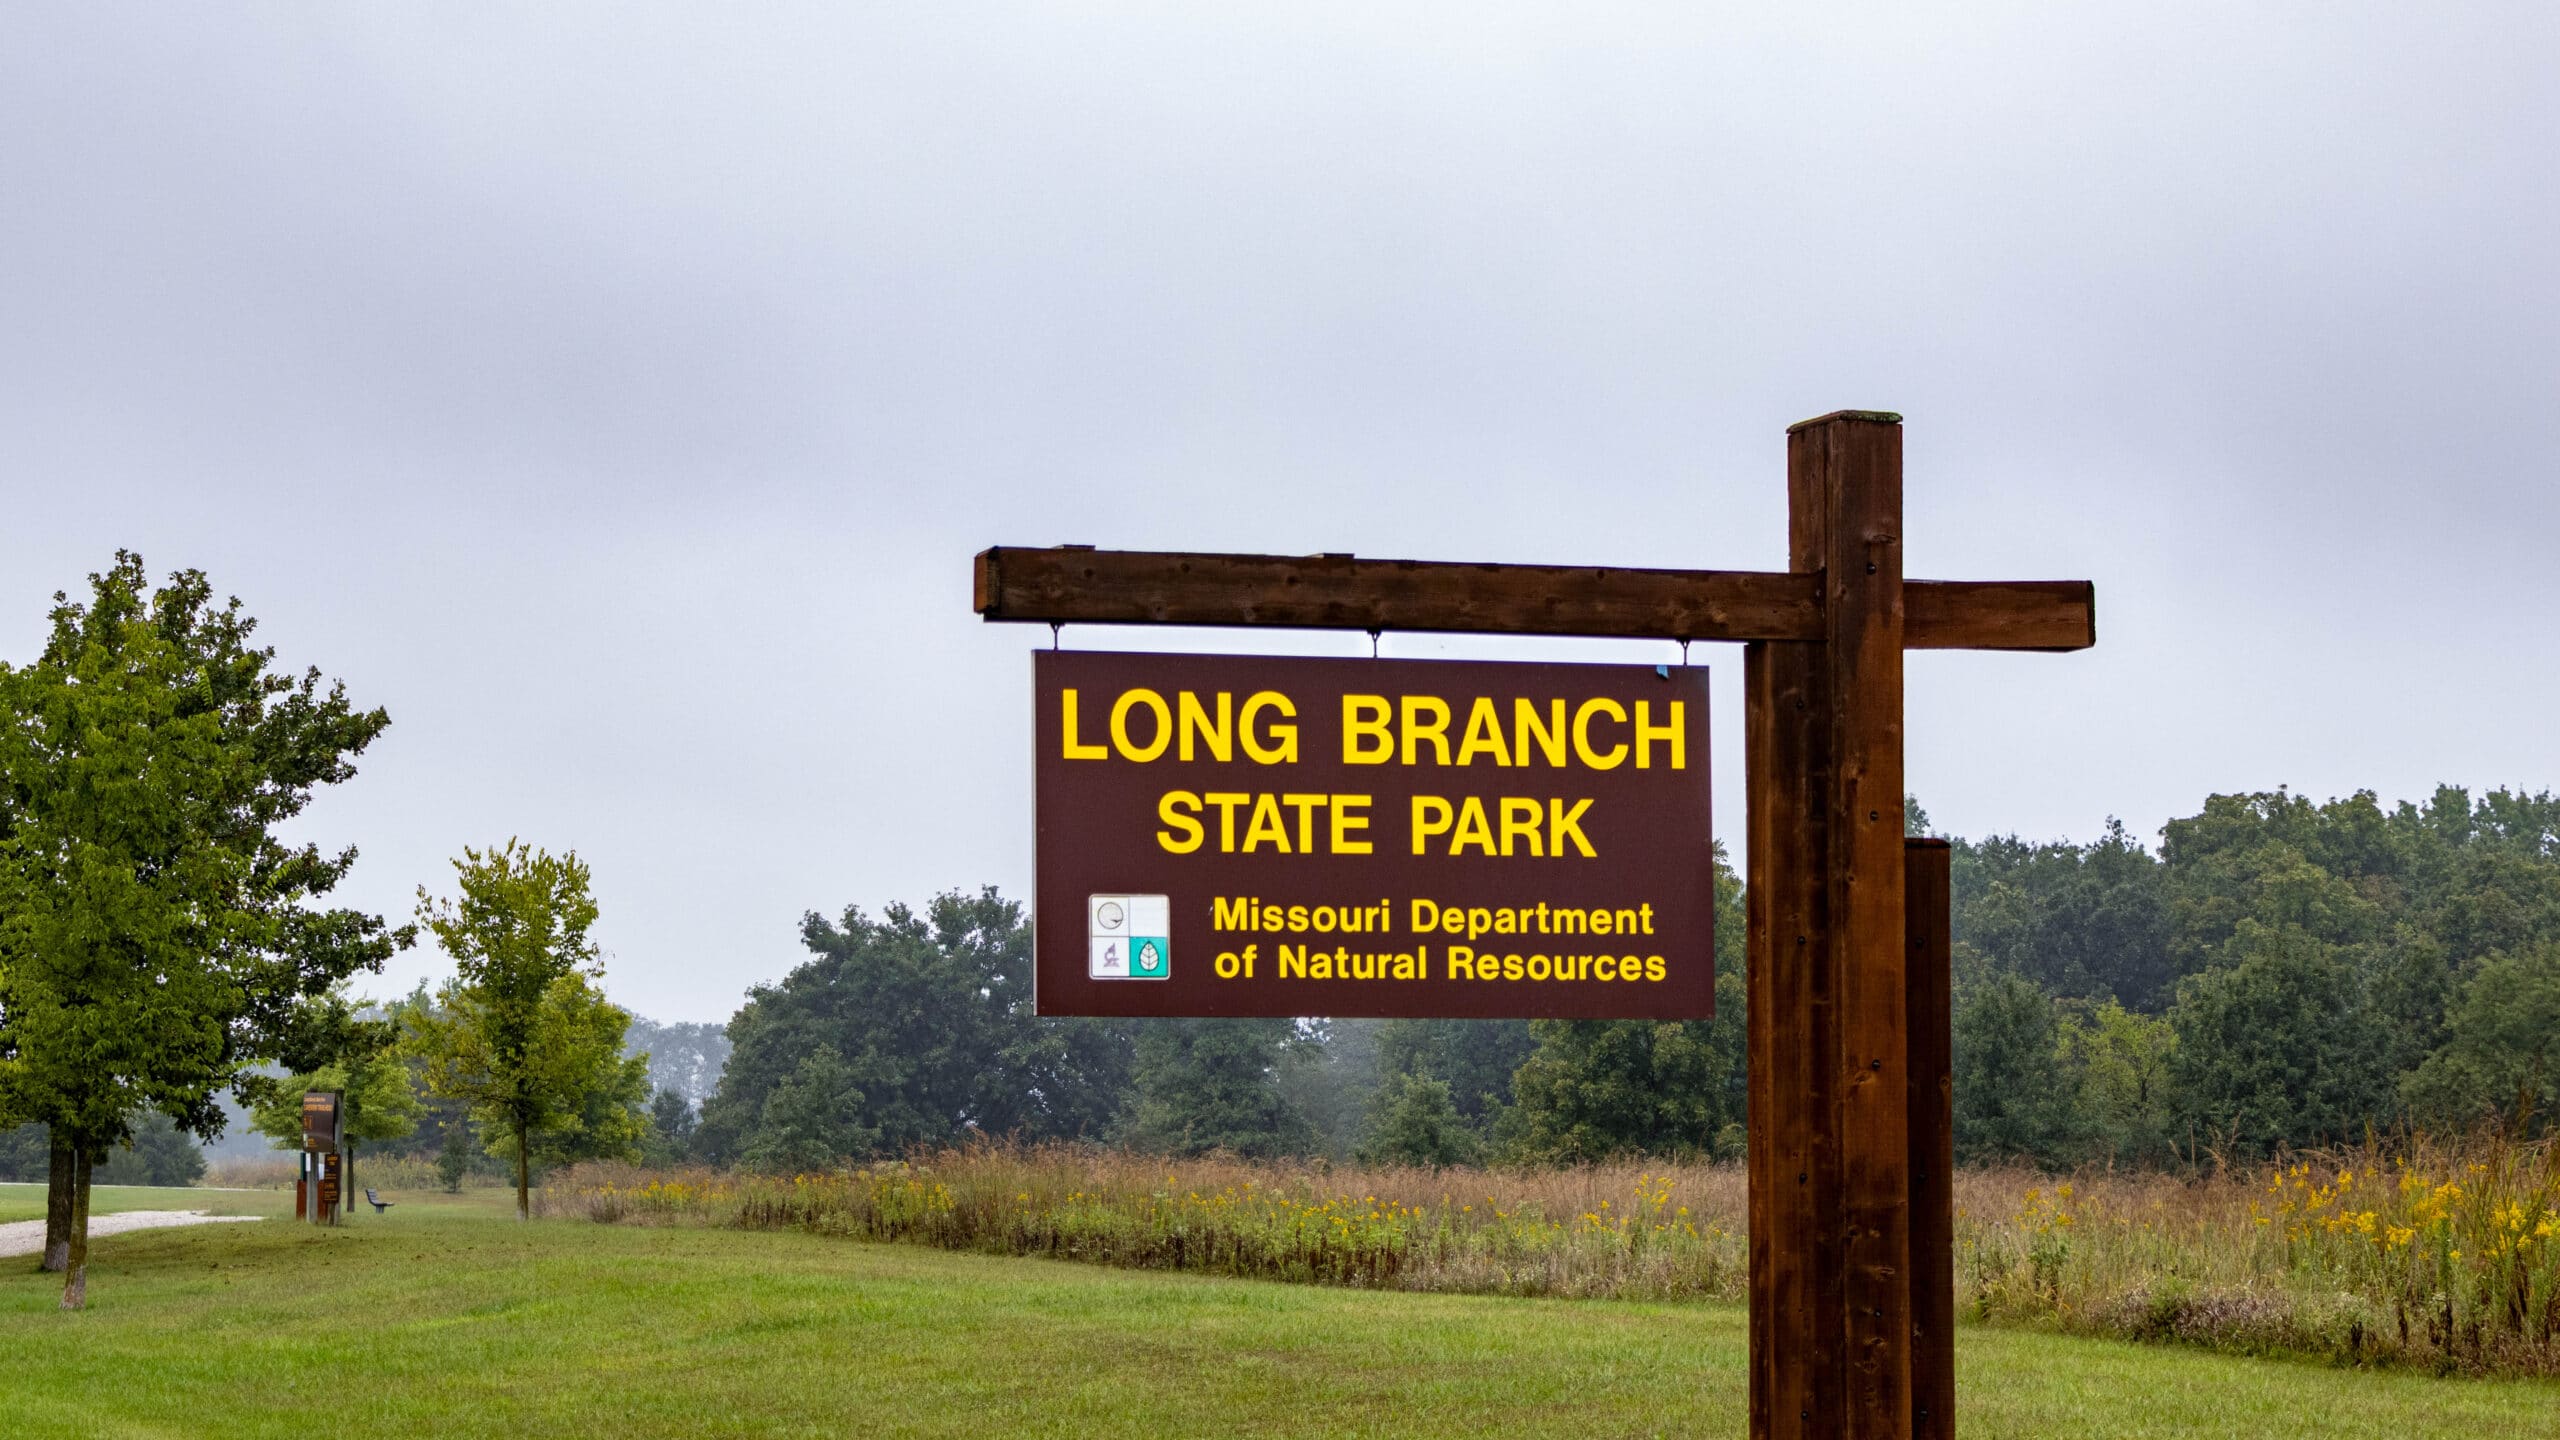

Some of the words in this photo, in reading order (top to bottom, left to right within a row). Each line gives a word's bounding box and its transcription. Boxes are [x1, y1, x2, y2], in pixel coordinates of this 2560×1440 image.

[1062, 688, 1298, 765] LONG
[1342, 695, 1687, 771] BRANCH
[1156, 790, 1374, 855] STATE
[1411, 795, 1598, 858] PARK
[1213, 896, 1390, 934] Missouri
[1411, 897, 1655, 942] Department
[1214, 944, 1258, 979] of
[1278, 944, 1427, 980] Natural
[1448, 945, 1667, 982] Resources
